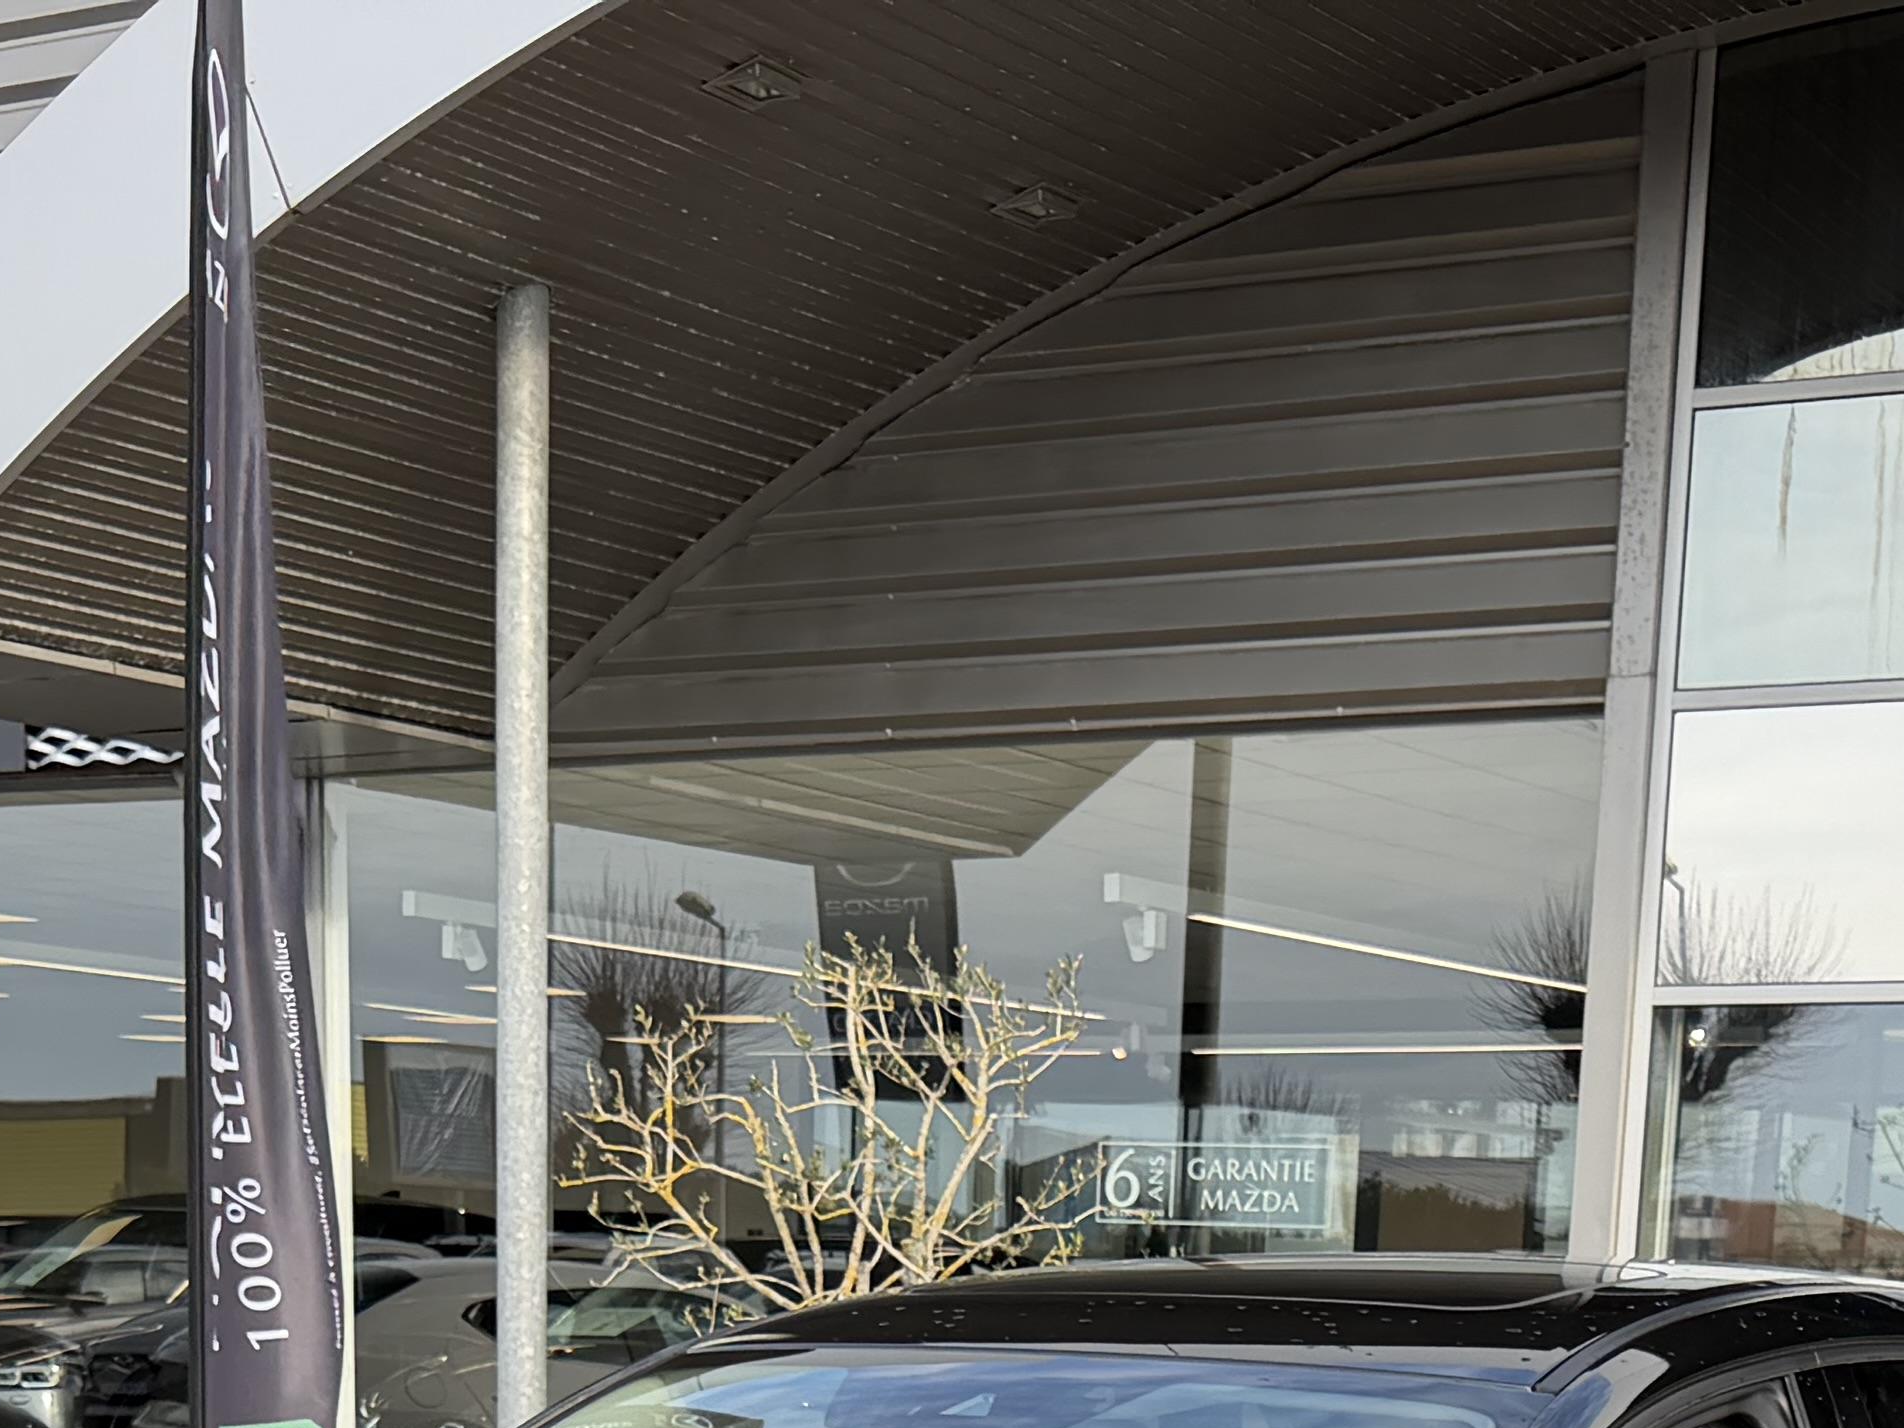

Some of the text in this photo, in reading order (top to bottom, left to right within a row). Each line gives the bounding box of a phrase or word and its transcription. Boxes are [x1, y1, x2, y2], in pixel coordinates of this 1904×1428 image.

[1104, 1147, 1166, 1208] 6 ANS
[1187, 1158, 1316, 1183] GARANTIE
[1200, 1189, 1300, 1214] MAZDA
[224, 1176, 290, 1354] 100%
